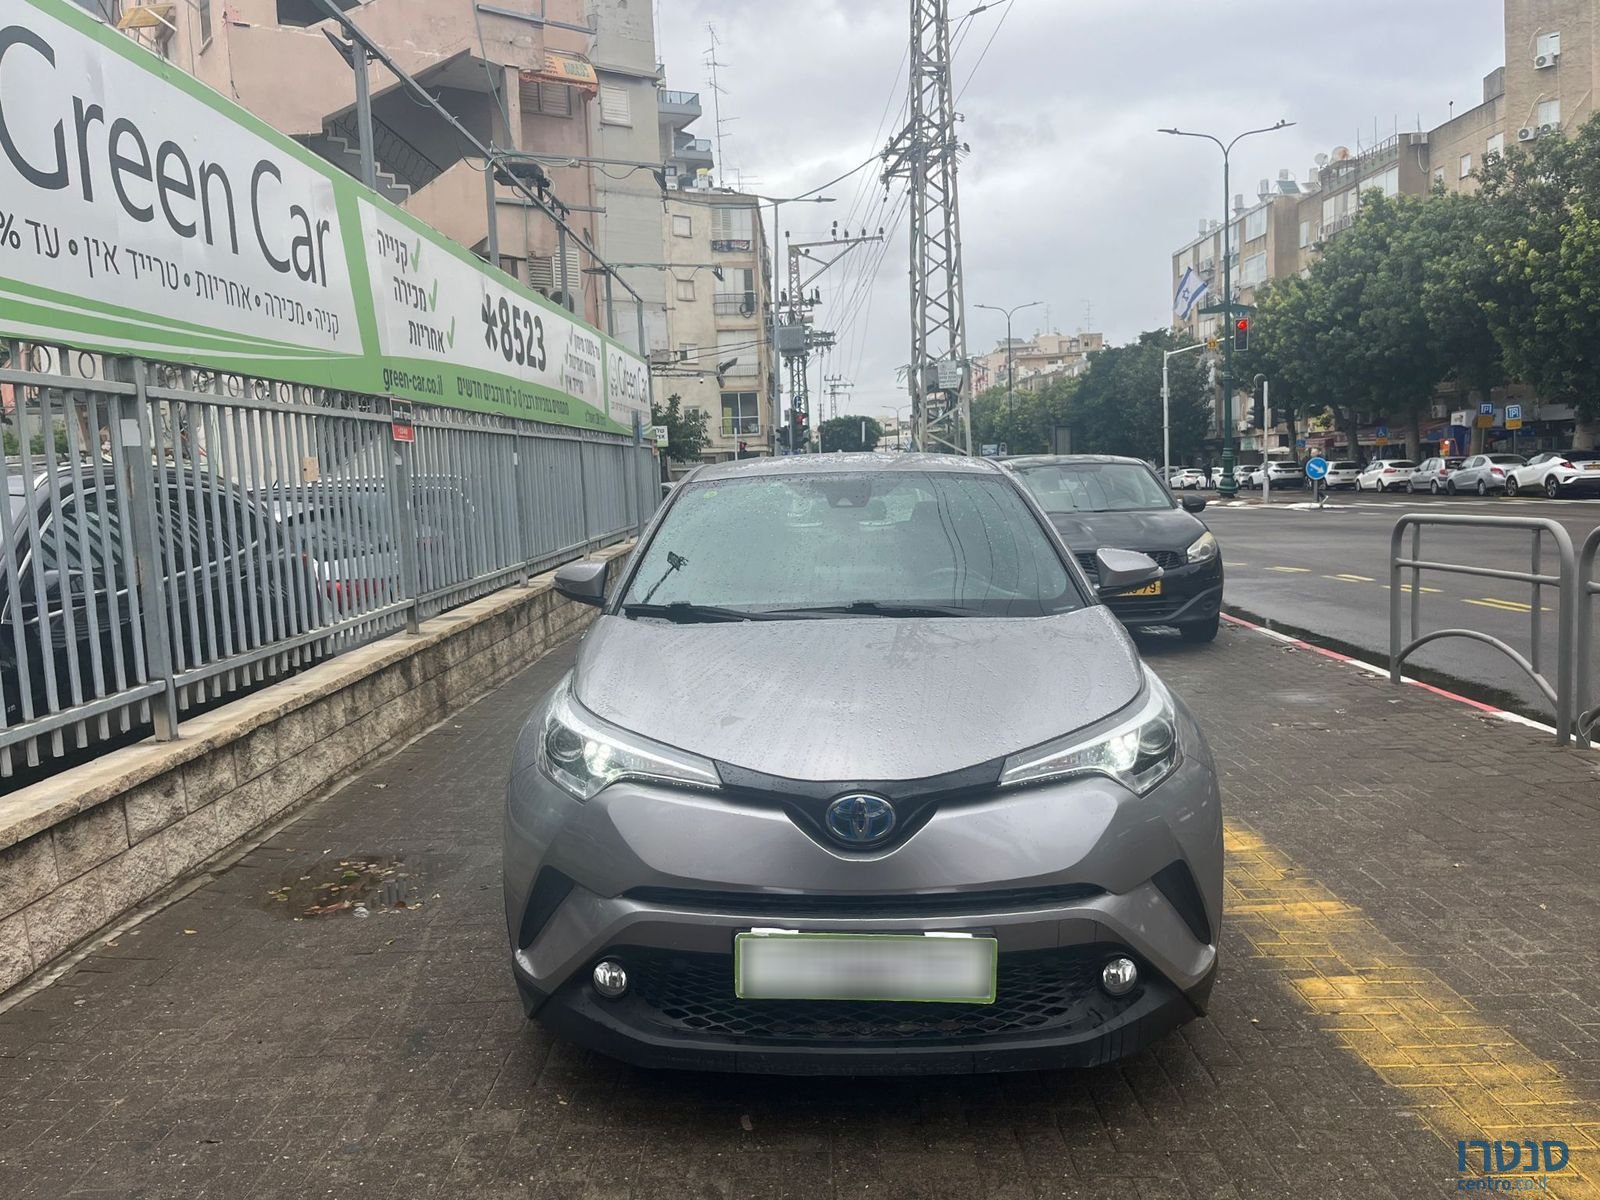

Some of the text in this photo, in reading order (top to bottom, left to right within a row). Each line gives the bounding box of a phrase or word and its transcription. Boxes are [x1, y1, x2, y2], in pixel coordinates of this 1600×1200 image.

[0, 25, 330, 287] Green Car
[25, 219, 60, 259] עד
[84, 236, 118, 279] אין
[376, 229, 409, 275] קנייה
[126, 248, 180, 290] טרייד
[195, 270, 252, 312] אחריות
[264, 291, 305, 325] מכירה
[393, 276, 427, 312] מכירה
[314, 307, 340, 341] קניה
[408, 319, 446, 354] אחריות
[382, 367, 444, 396] green-car.co.il
